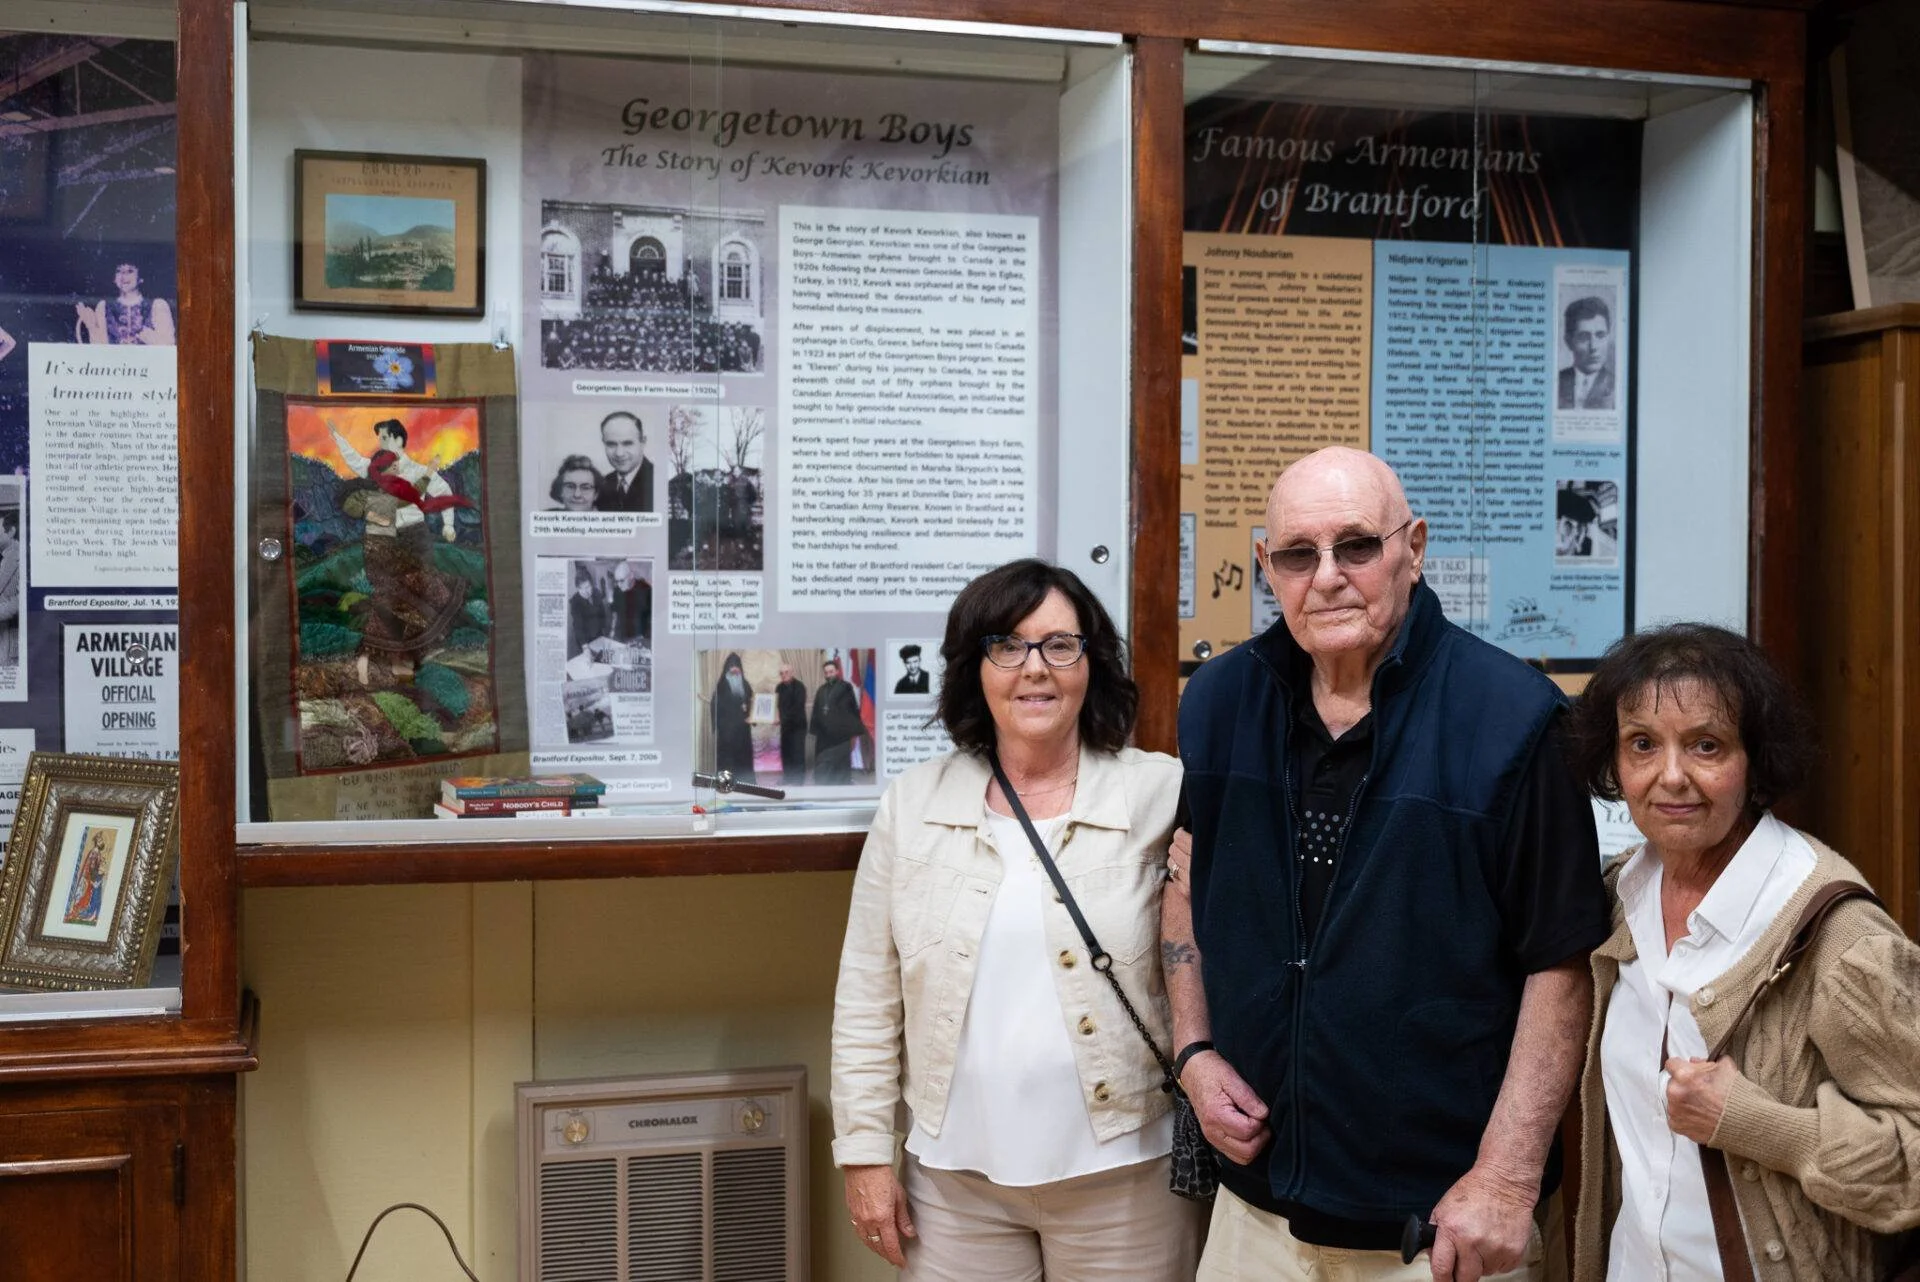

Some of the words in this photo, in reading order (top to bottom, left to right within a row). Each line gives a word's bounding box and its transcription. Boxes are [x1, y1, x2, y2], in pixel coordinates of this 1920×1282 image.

[622, 98, 865, 148] Georgetown
[878, 113, 975, 160] Boys
[1192, 127, 1335, 163] Famous
[1346, 135, 1541, 173] Armenians
[601, 144, 648, 168] The
[656, 150, 721, 180] Story
[730, 151, 759, 182] of
[762, 156, 854, 180] Kevork
[860, 161, 990, 185] Kevorkian
[1260, 177, 1299, 222] of
[1304, 183, 1488, 227] Brantford
[793, 222, 811, 230] This
[816, 223, 823, 231] is
[827, 223, 841, 232] the
[846, 225, 866, 235] story
[871, 225, 880, 234] of
[884, 226, 913, 235] Kevork
[965, 229, 983, 238] also
[986, 230, 1013, 239] known
[793, 235, 823, 246] George
[870, 238, 910, 248] Kevorkian
[951, 242, 960, 250] of
[962, 242, 975, 251] the
[977, 243, 1028, 255] Georgetown
[1204, 247, 1241, 259] Johnny
[793, 302, 834, 312] homeland
[837, 304, 862, 314] during
[865, 305, 879, 313] the
[348, 344, 378, 352] Armenian
[45, 360, 74, 375] It's
[79, 362, 149, 378] dancing
[577, 384, 621, 393] Georgetown
[624, 385, 642, 394] Boys
[793, 515, 844, 525] hardworking
[849, 515, 886, 525] milkman,
[891, 516, 920, 524] Kevork
[922, 516, 953, 524] worked
[956, 516, 994, 527] tirelessly
[998, 517, 1010, 525] for
[552, 526, 585, 535] Wedding
[587, 526, 632, 535] Anniversary
[822, 528, 867, 538] embodying
[872, 529, 911, 537] resilience
[914, 529, 929, 537] and
[933, 529, 990, 538] determination
[994, 530, 1024, 540] despite
[792, 541, 805, 549] the
[809, 541, 849, 552] hardships
[852, 542, 862, 550] he
[741, 579, 759, 587] Tony
[696, 590, 722, 598] George
[48, 598, 88, 606] Brantford
[89, 598, 129, 608] Expositor,
[151, 599, 162, 607] 14,
[672, 601, 690, 609] They
[715, 601, 759, 609] Georgetown
[672, 612, 690, 620] Boys
[76, 632, 176, 652] ARMENIAN
[91, 658, 163, 677] VILLAGE
[102, 685, 156, 702] OFFICIAL
[102, 712, 156, 728] OPENING
[533, 754, 568, 762] Brantford
[503, 801, 539, 809] NOBODY'S
[628, 1115, 698, 1129] CHROMALOX
